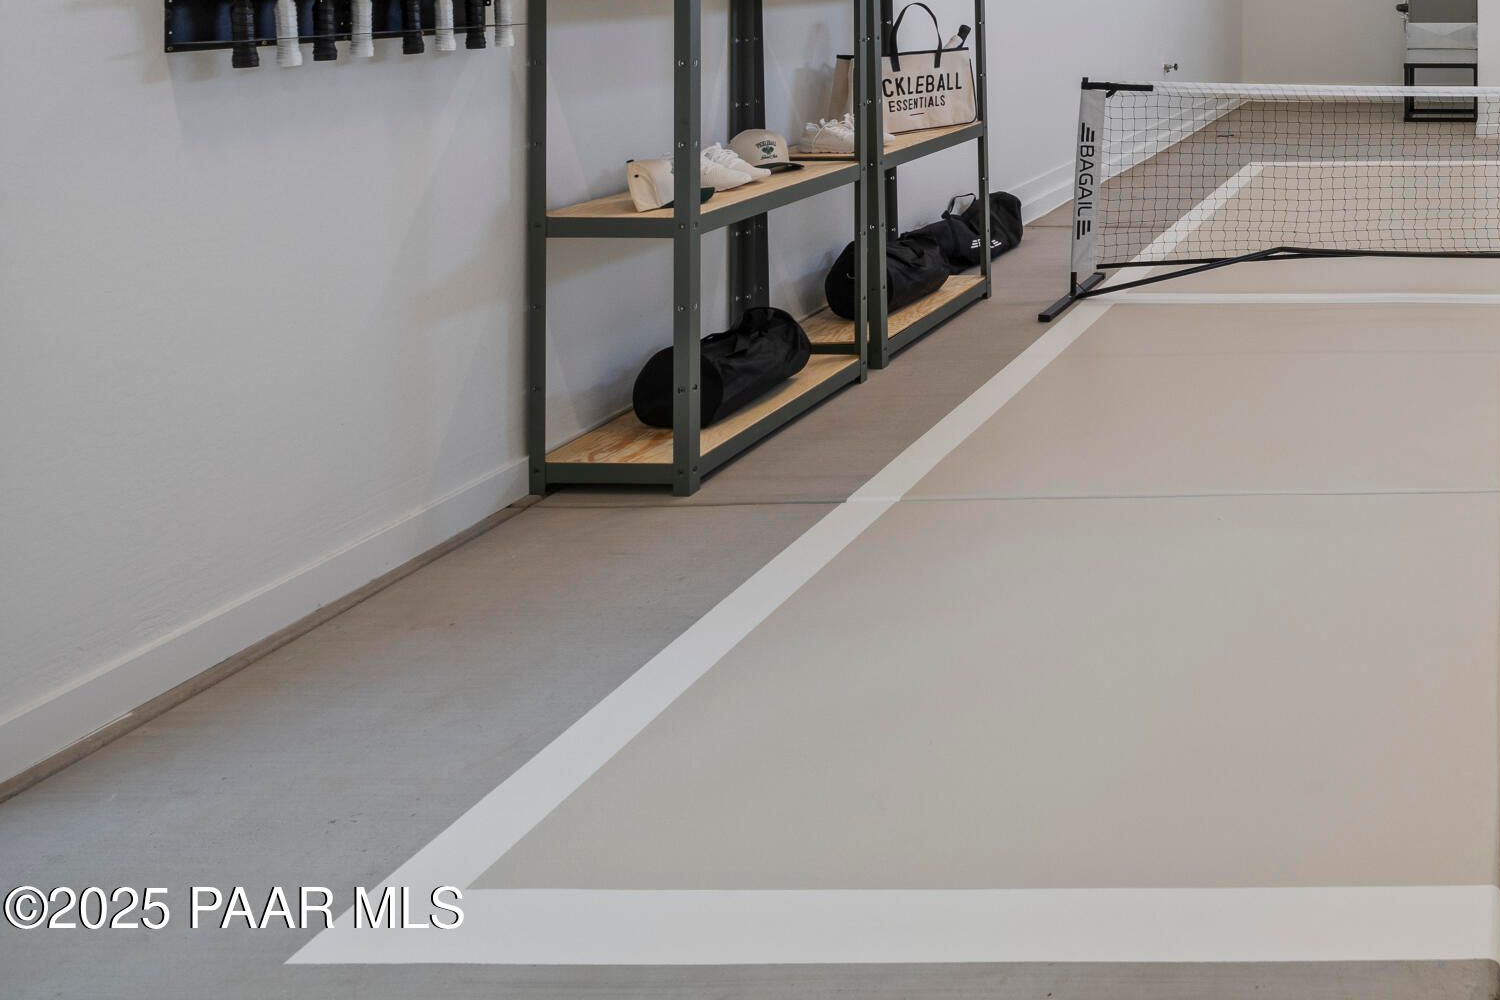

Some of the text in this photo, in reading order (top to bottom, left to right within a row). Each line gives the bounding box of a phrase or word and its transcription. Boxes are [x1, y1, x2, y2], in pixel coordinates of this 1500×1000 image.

[882, 72, 963, 98] CKLEBALL
[888, 95, 946, 113] ESSENTIALS
[1078, 145, 1095, 217] BAGAIL
